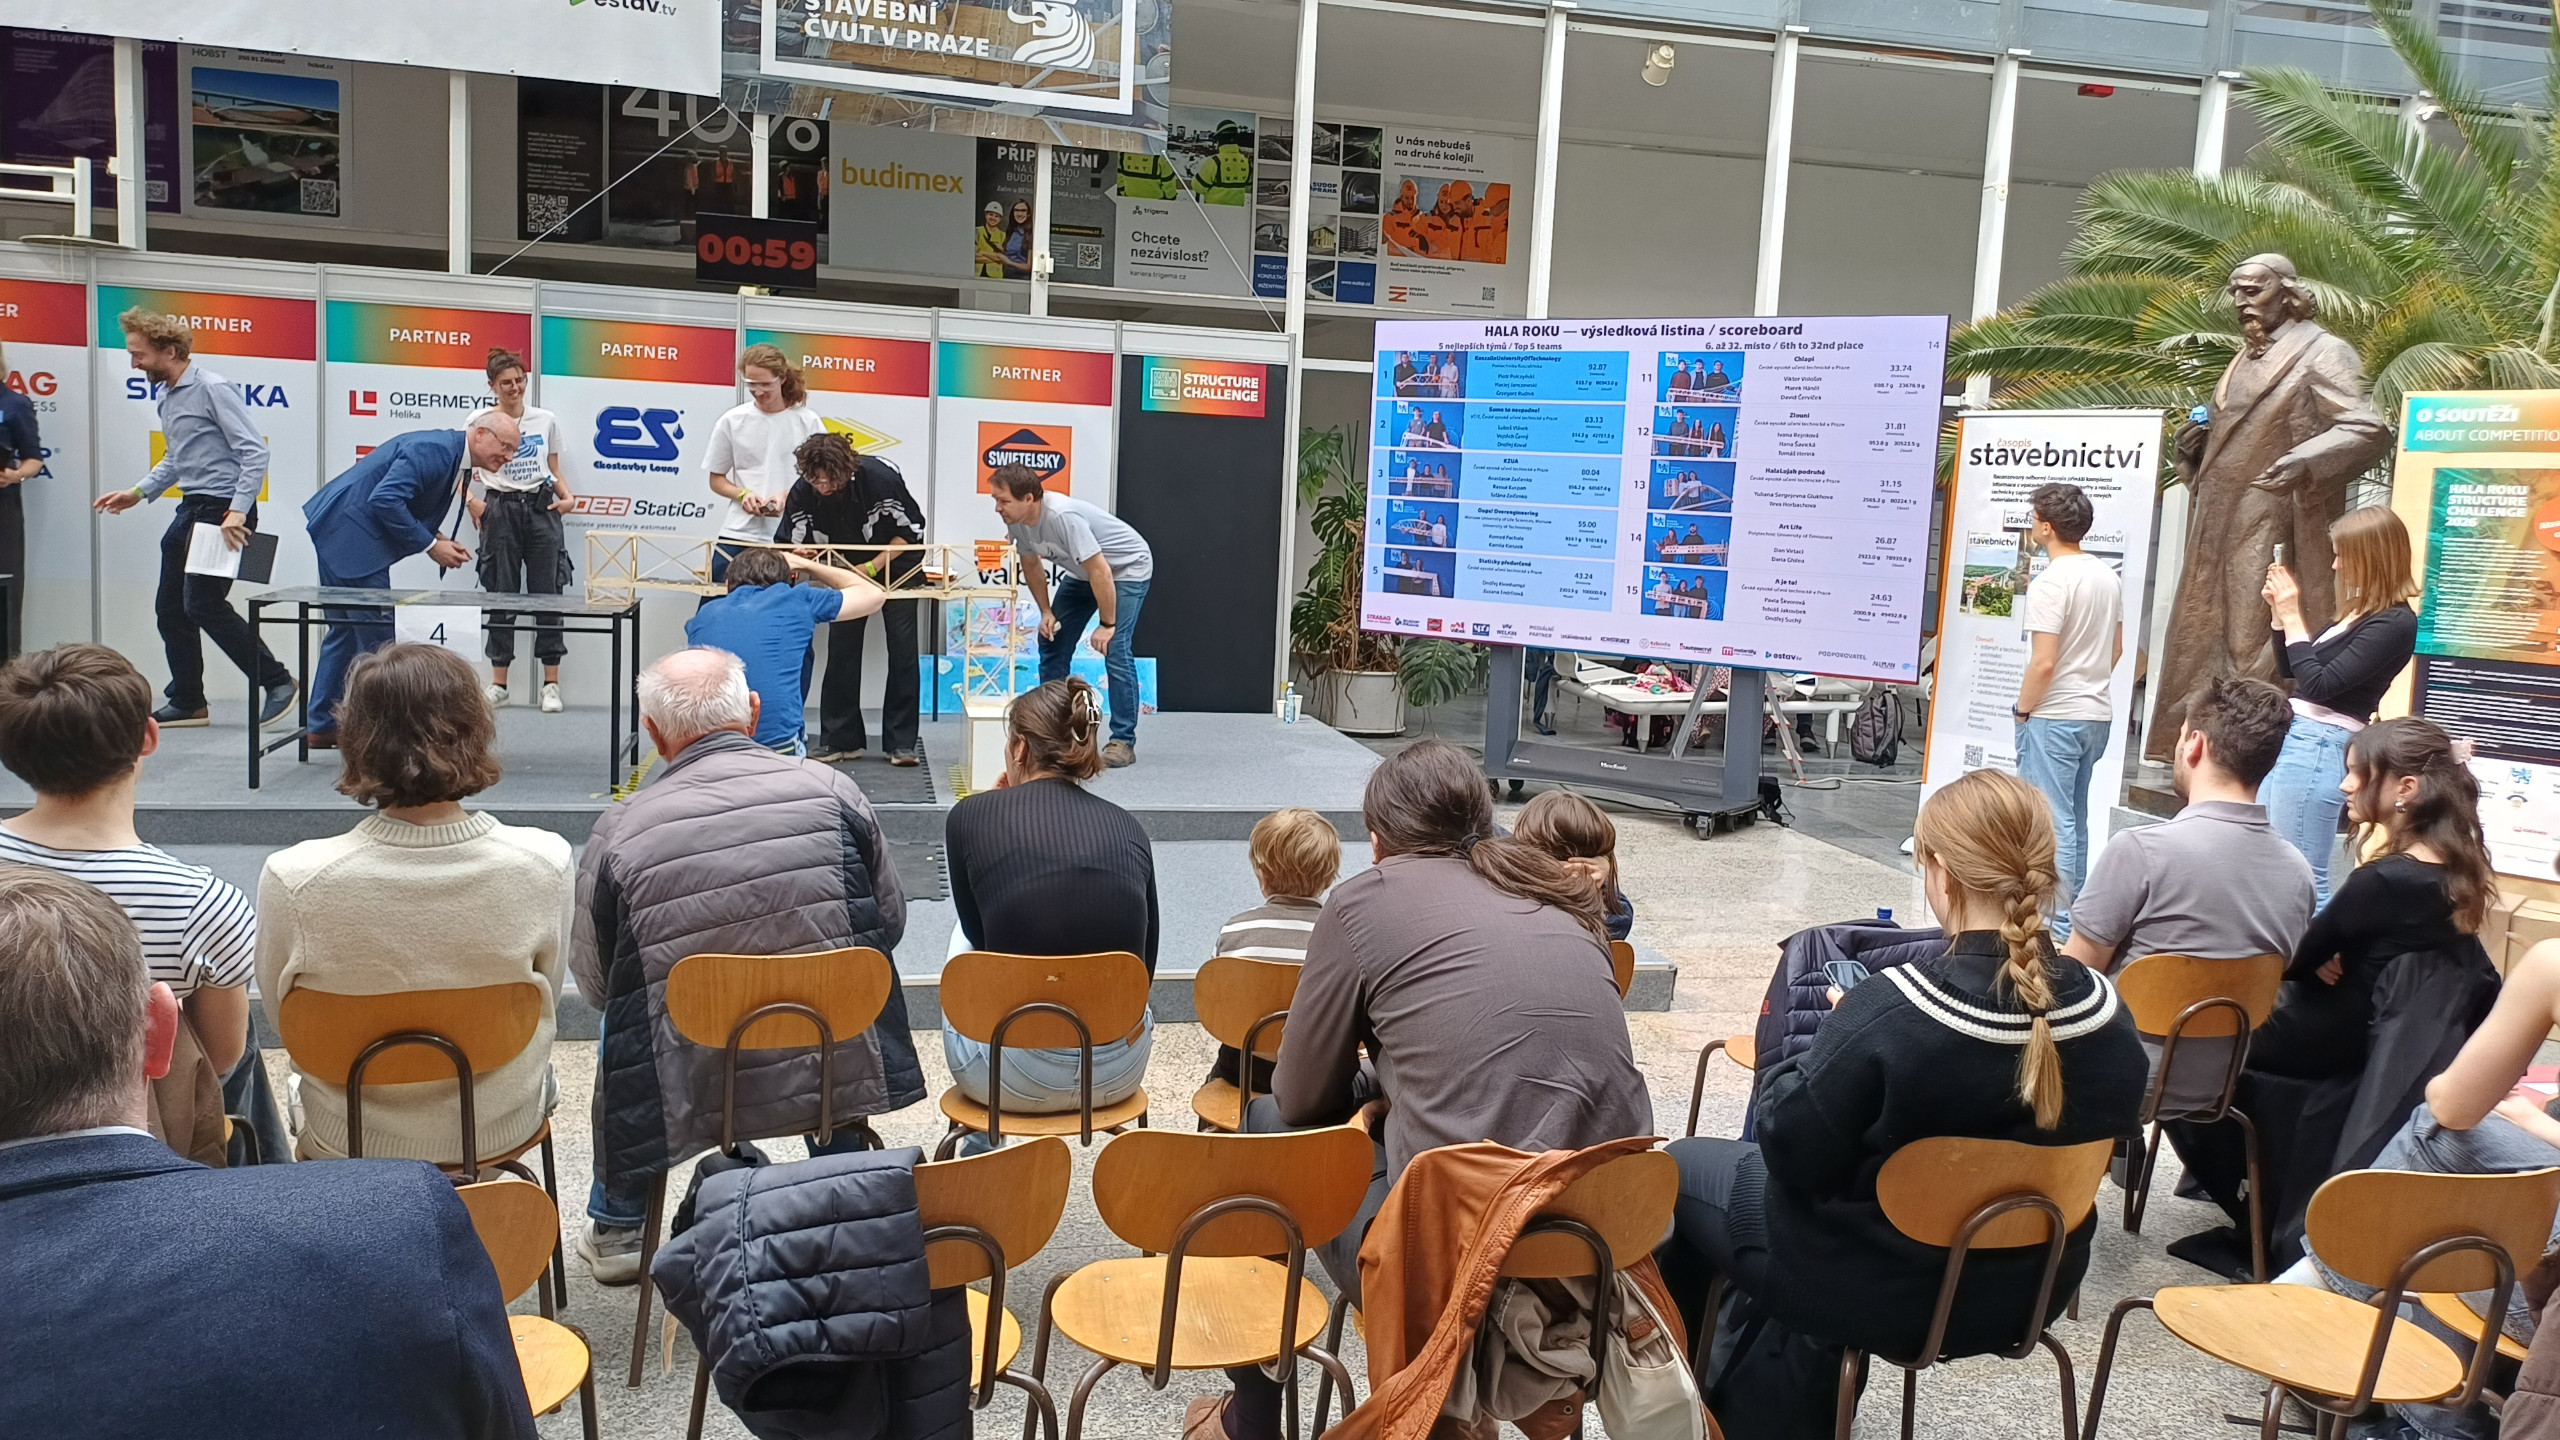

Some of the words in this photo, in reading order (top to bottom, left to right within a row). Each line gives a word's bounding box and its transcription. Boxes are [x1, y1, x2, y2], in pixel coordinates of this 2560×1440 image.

[804, 12, 875, 44] ČVUT
[880, 26, 899, 47] V
[906, 29, 990, 57] PRAZE
[191, 48, 227, 58] HOBST
[1395, 135, 1404, 144] U
[1406, 136, 1425, 147] nás
[1427, 139, 1471, 151] nebudeš
[997, 142, 1098, 169] PŘIPAVENI
[1394, 149, 1408, 157] na
[1410, 149, 1441, 160] druhé
[1443, 152, 1474, 164] koleji!
[841, 157, 964, 195] budimex
[1312, 181, 1338, 189] SUDOP
[1144, 208, 1169, 216] trigema
[1131, 231, 1181, 245] Chcete
[698, 233, 816, 270] 00:59
[1130, 247, 1209, 263] nezávislost?
[389, 328, 471, 346] PARTNER
[1484, 325, 1519, 337] HALA
[1521, 325, 1560, 337] ROKU
[1580, 325, 1658, 339] výsledková
[1660, 324, 1705, 337] listina
[1718, 323, 1803, 336] scoreboard
[601, 342, 679, 361] PARTNER
[1444, 342, 1483, 352] nejlepších
[1484, 342, 1507, 352] týmů
[1514, 343, 1529, 351] Top
[1536, 343, 1563, 351] teams
[1705, 342, 1713, 351] 6.
[1728, 341, 1742, 351] 32.
[1744, 341, 1771, 351] místo
[1780, 341, 1797, 351] 6th
[1798, 342, 1808, 351] to
[1810, 341, 1835, 351] 32nd
[1837, 341, 1864, 352] place
[1928, 341, 1940, 350] 14
[802, 354, 876, 373] PARTNER
[992, 365, 1062, 383] PARTNER
[1383, 370, 1388, 379] 1
[1641, 373, 1653, 383] 11
[1183, 372, 1259, 389] STRUCTURE
[1182, 386, 1259, 402] CHALLENGE
[389, 409, 421, 420] Helika
[2416, 408, 2433, 423] O
[2434, 403, 2519, 424] SOUTĚŽI
[1380, 420, 1386, 429] 2
[1637, 427, 1649, 437] 12
[2414, 429, 2467, 442] ABOUT
[1996, 437, 2032, 449] časopis
[988, 451, 1061, 469] SWIETELSKY
[1968, 441, 2144, 469] stavebnictví
[1378, 469, 1384, 478] 3
[1633, 480, 1646, 490] 13
[1880, 480, 1902, 488] 31.15
[2448, 484, 2485, 495] HALA
[2486, 484, 2528, 496] ROKU
[2447, 494, 2528, 507] STRUCTURE
[2446, 505, 2527, 518] CHALLENGE
[1375, 517, 1381, 526] 4
[2444, 516, 2478, 528] 2026
[1629, 533, 1642, 543] 14
[1969, 535, 2018, 547] stavebnictví
[1372, 565, 1378, 575] 5
[1626, 585, 1639, 595] 15
[429, 622, 448, 645] 4
